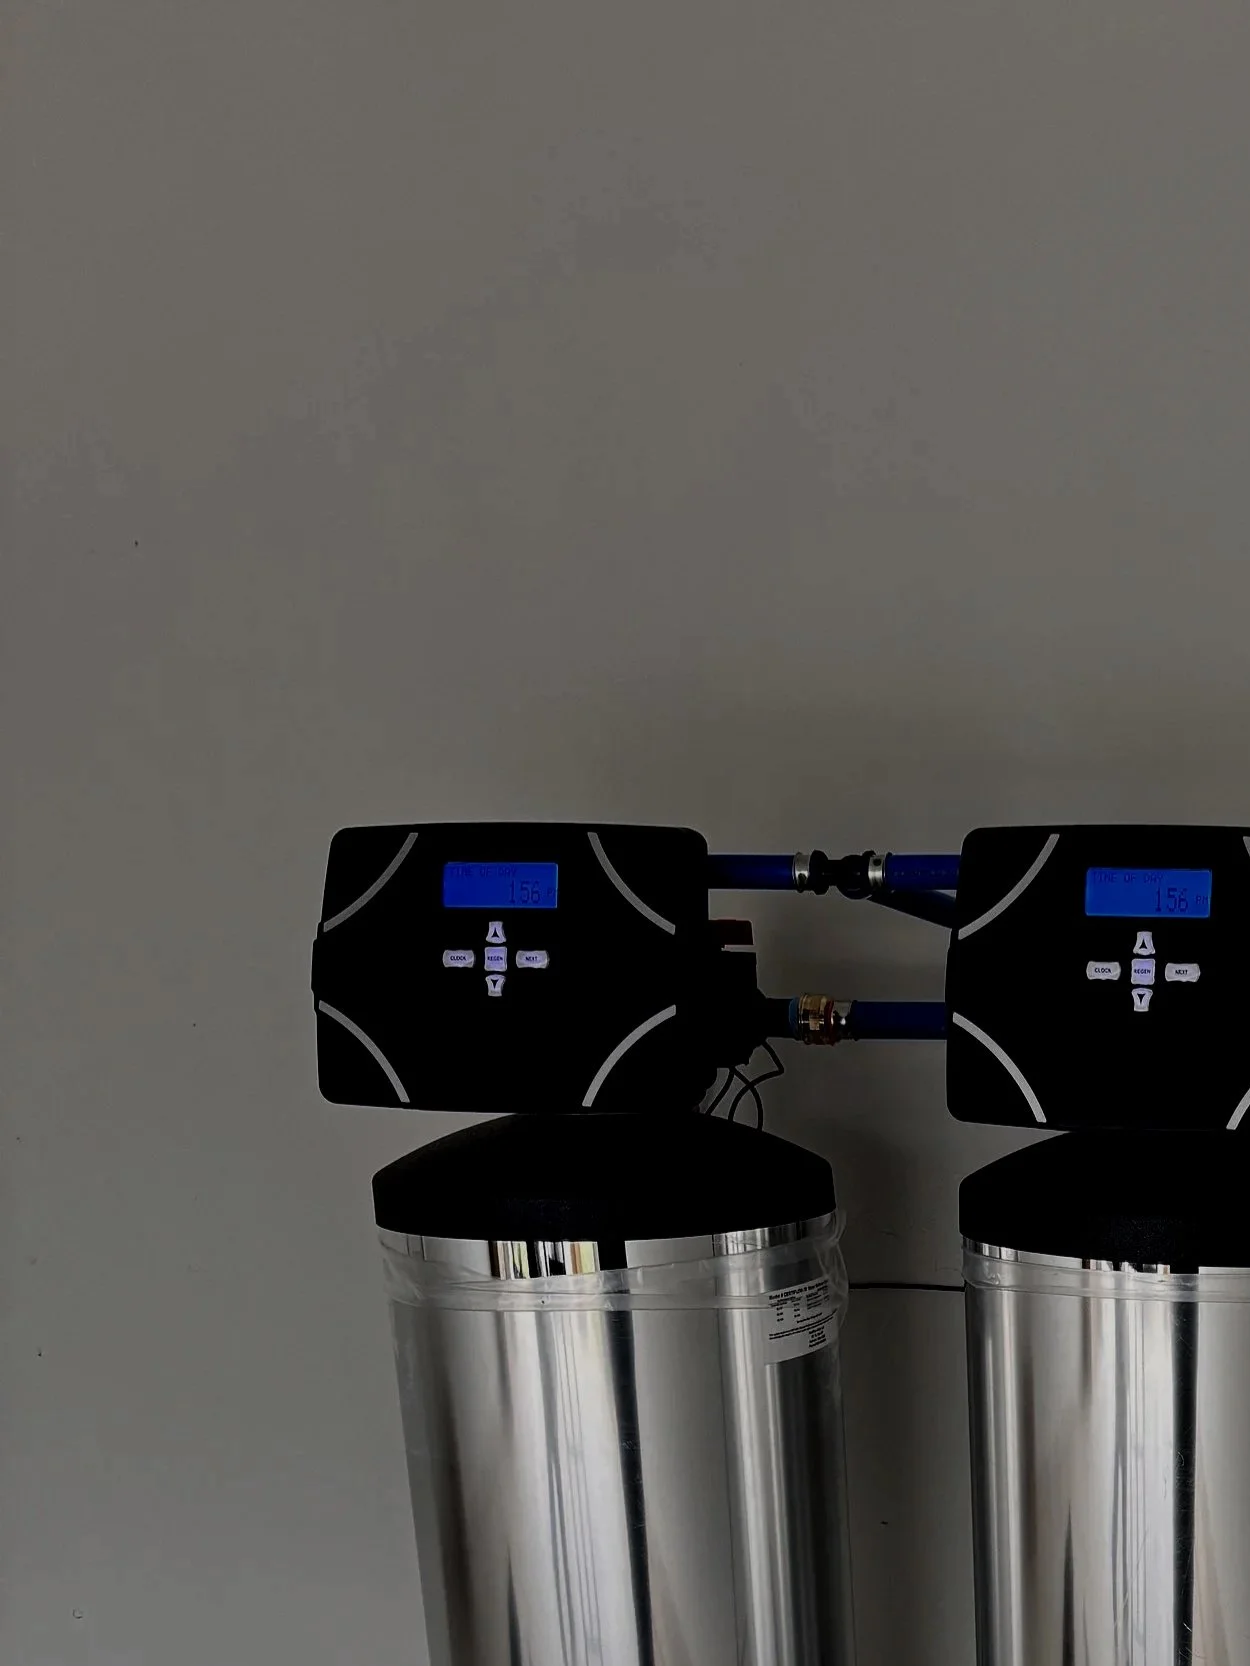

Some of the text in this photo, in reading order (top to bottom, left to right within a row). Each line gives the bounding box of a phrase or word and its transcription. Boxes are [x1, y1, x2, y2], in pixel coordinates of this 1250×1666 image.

[450, 866, 474, 878] TIME
[479, 866, 492, 878] OF
[1092, 871, 1164, 884] TIME OF DAY
